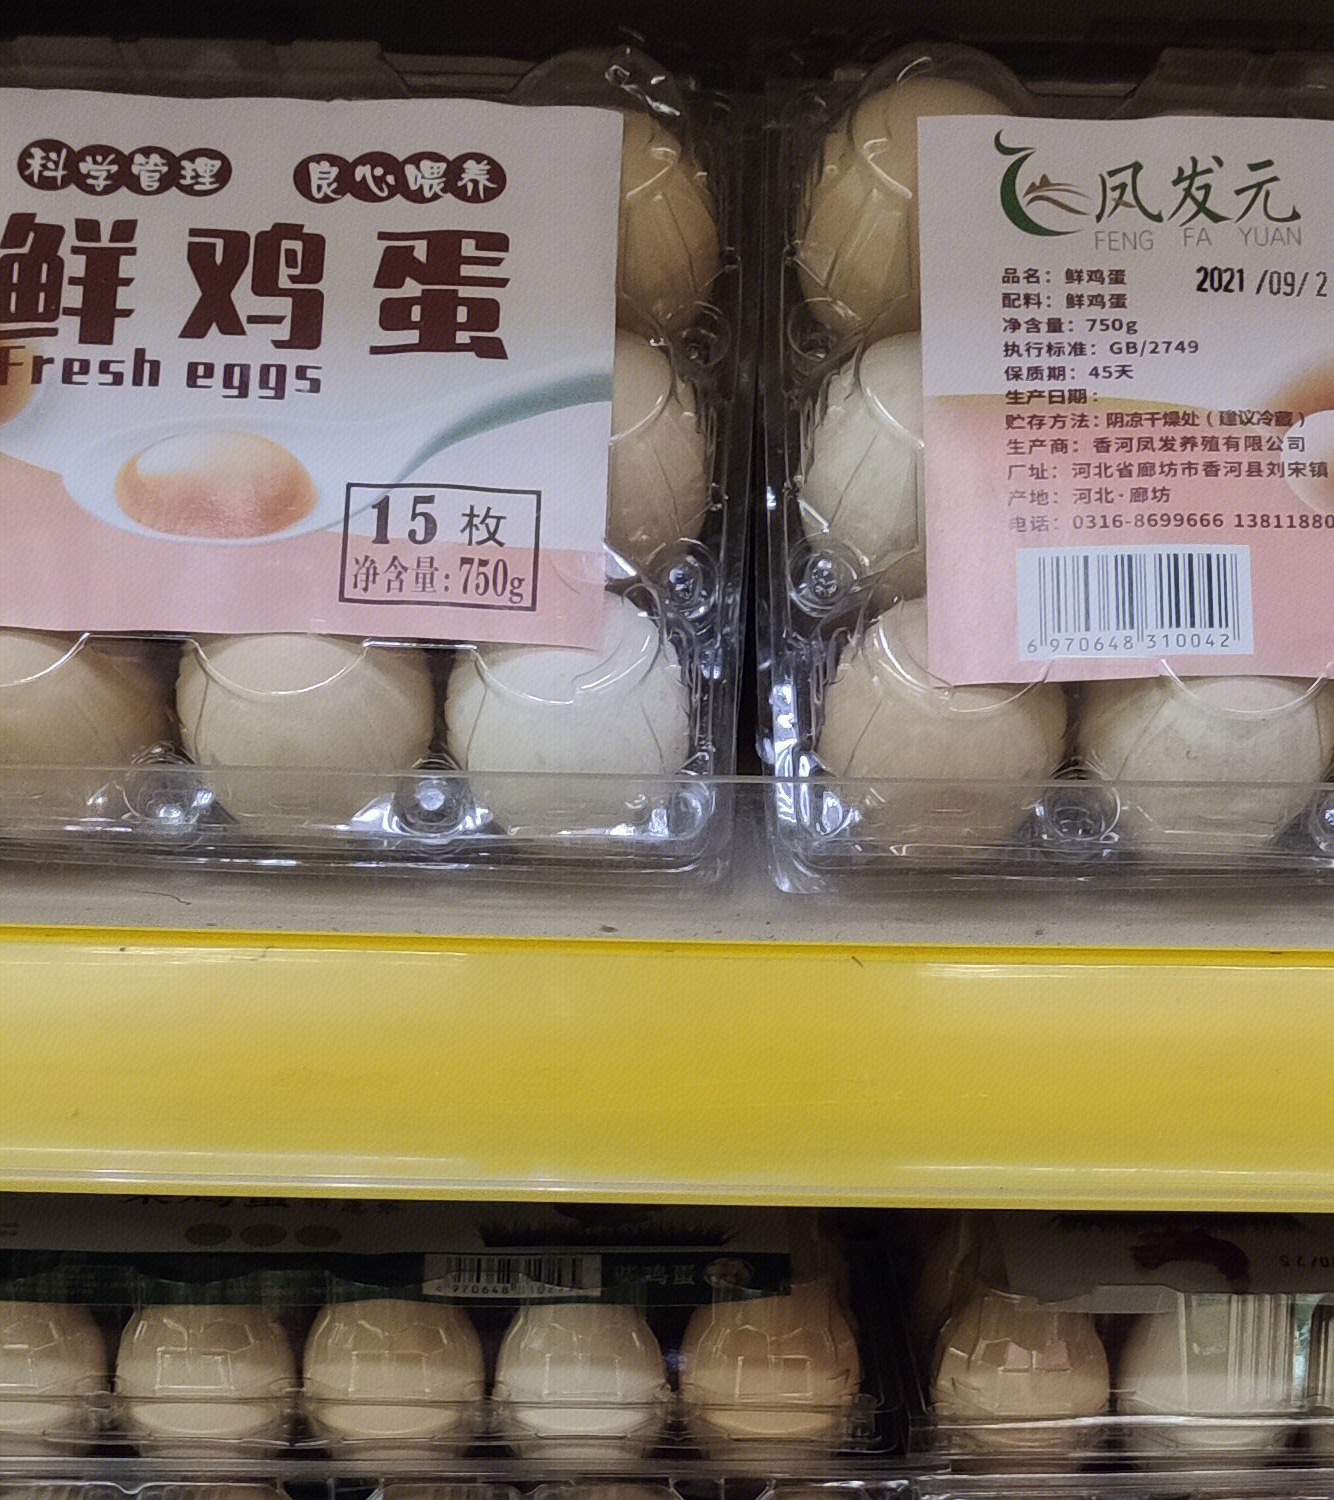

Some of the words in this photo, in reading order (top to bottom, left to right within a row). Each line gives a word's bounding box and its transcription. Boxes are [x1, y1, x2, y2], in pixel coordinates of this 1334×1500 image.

[22, 145, 229, 192] 科学管理
[303, 156, 501, 201] 良心喂养
[1095, 156, 1302, 227] 凤发元
[1094, 230, 1154, 251] FENG
[1183, 226, 1211, 247] FA
[1239, 225, 1301, 247] YUAN
[186, 359, 323, 400] eggs
